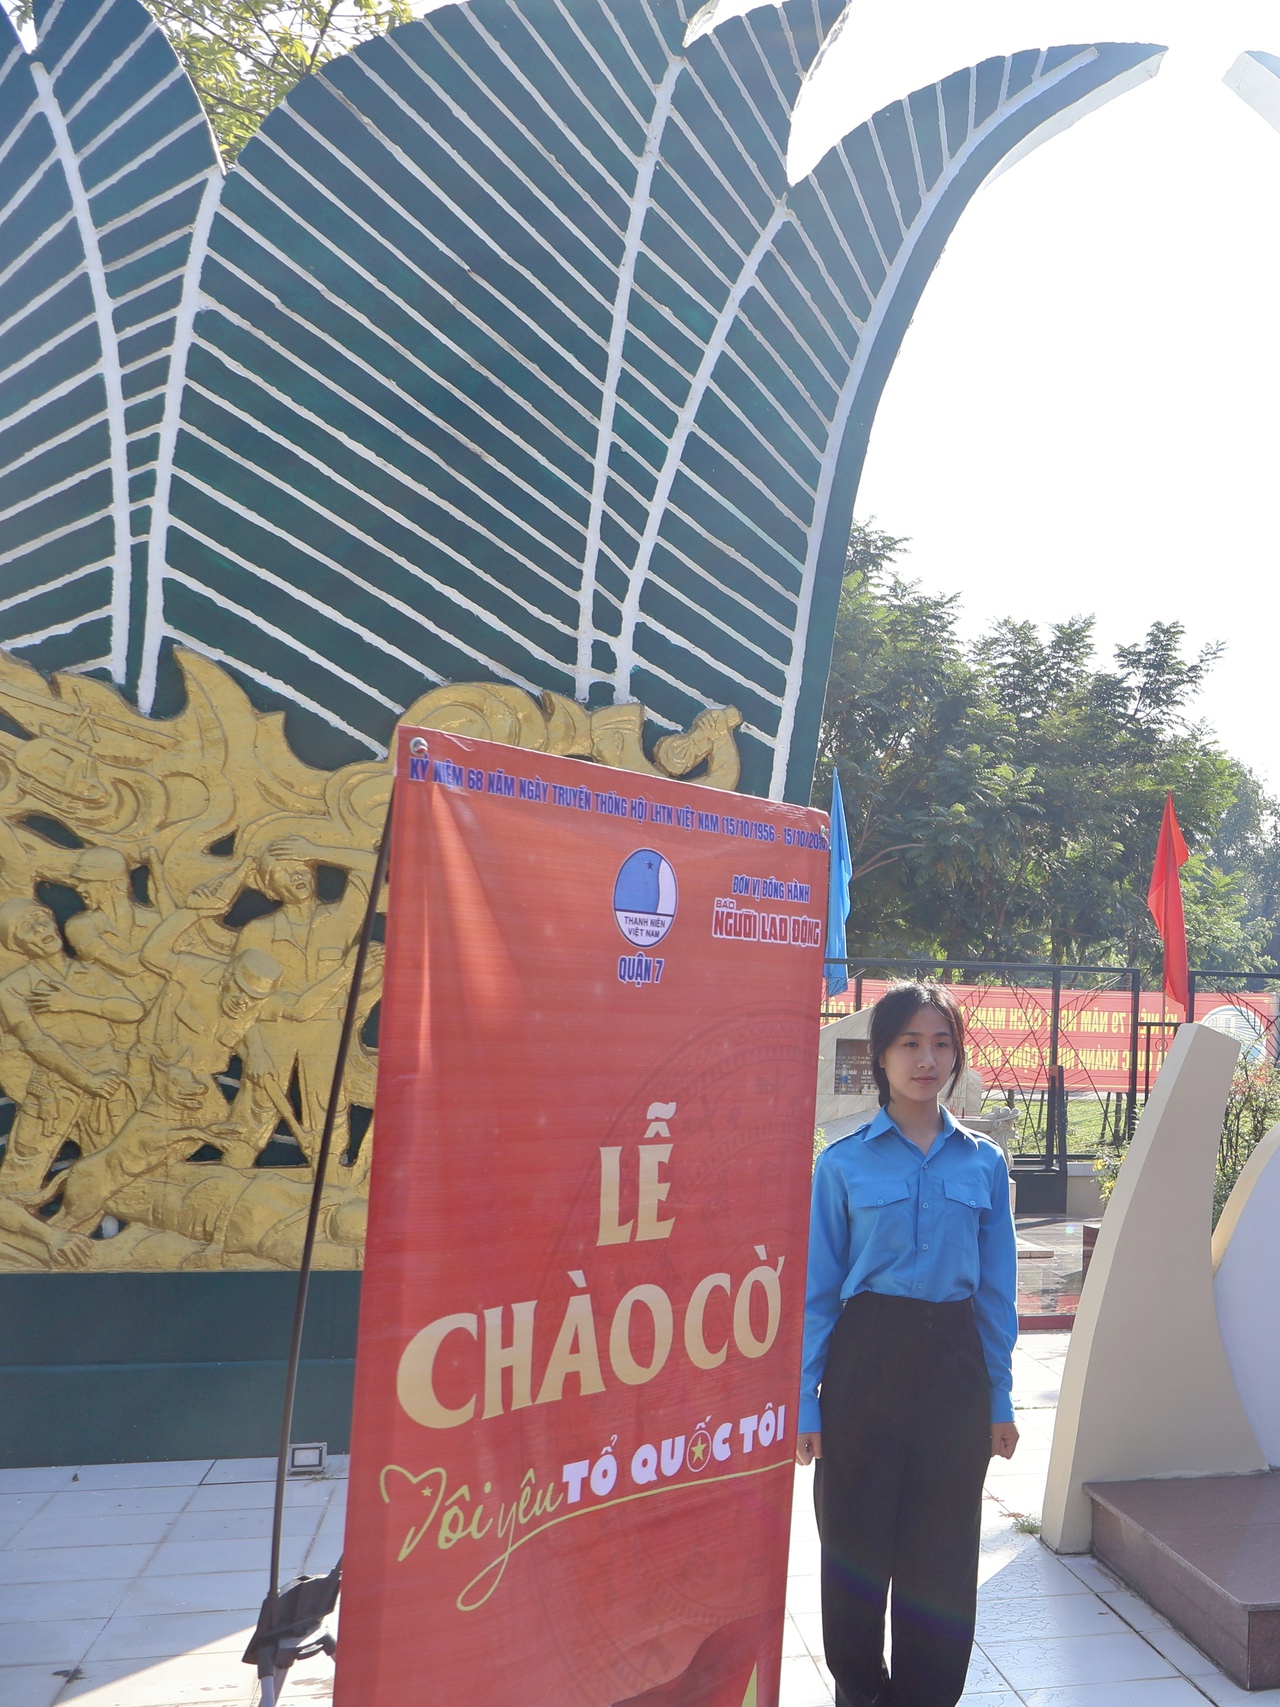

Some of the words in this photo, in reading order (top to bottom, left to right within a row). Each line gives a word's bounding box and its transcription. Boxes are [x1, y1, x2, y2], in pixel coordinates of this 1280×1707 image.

[467, 767, 484, 793] 68
[486, 768, 516, 798] NĂM
[518, 775, 549, 804] NGÀY
[552, 784, 592, 812] TRUYỀN
[594, 790, 628, 818] THỐNG
[630, 795, 648, 825] HỘI
[650, 802, 674, 826] LHTN
[675, 804, 696, 832] VIỆT
[697, 811, 720, 834] NAM
[721, 816, 775, 843] (15/10/1956
[732, 874, 751, 896] ĐƠN
[751, 876, 762, 901] VỊ
[787, 878, 811, 904] HÀNH
[624, 915, 649, 927] THANH
[649, 917, 666, 929] NIÊN
[628, 926, 644, 938] VIỆT
[645, 929, 660, 938] NAM
[760, 913, 789, 944] LAO
[791, 915, 822, 947] ĐỘNG
[618, 951, 653, 988] QUẬN
[654, 957, 665, 984] 7
[596, 1101, 676, 1247] LỄ
[396, 1269, 674, 1430] CHÀO
[684, 1244, 786, 1370] CỜ
[562, 1433, 619, 1504] TỔ
[631, 1413, 734, 1486] QUỐC
[739, 1401, 786, 1453] TÔI
